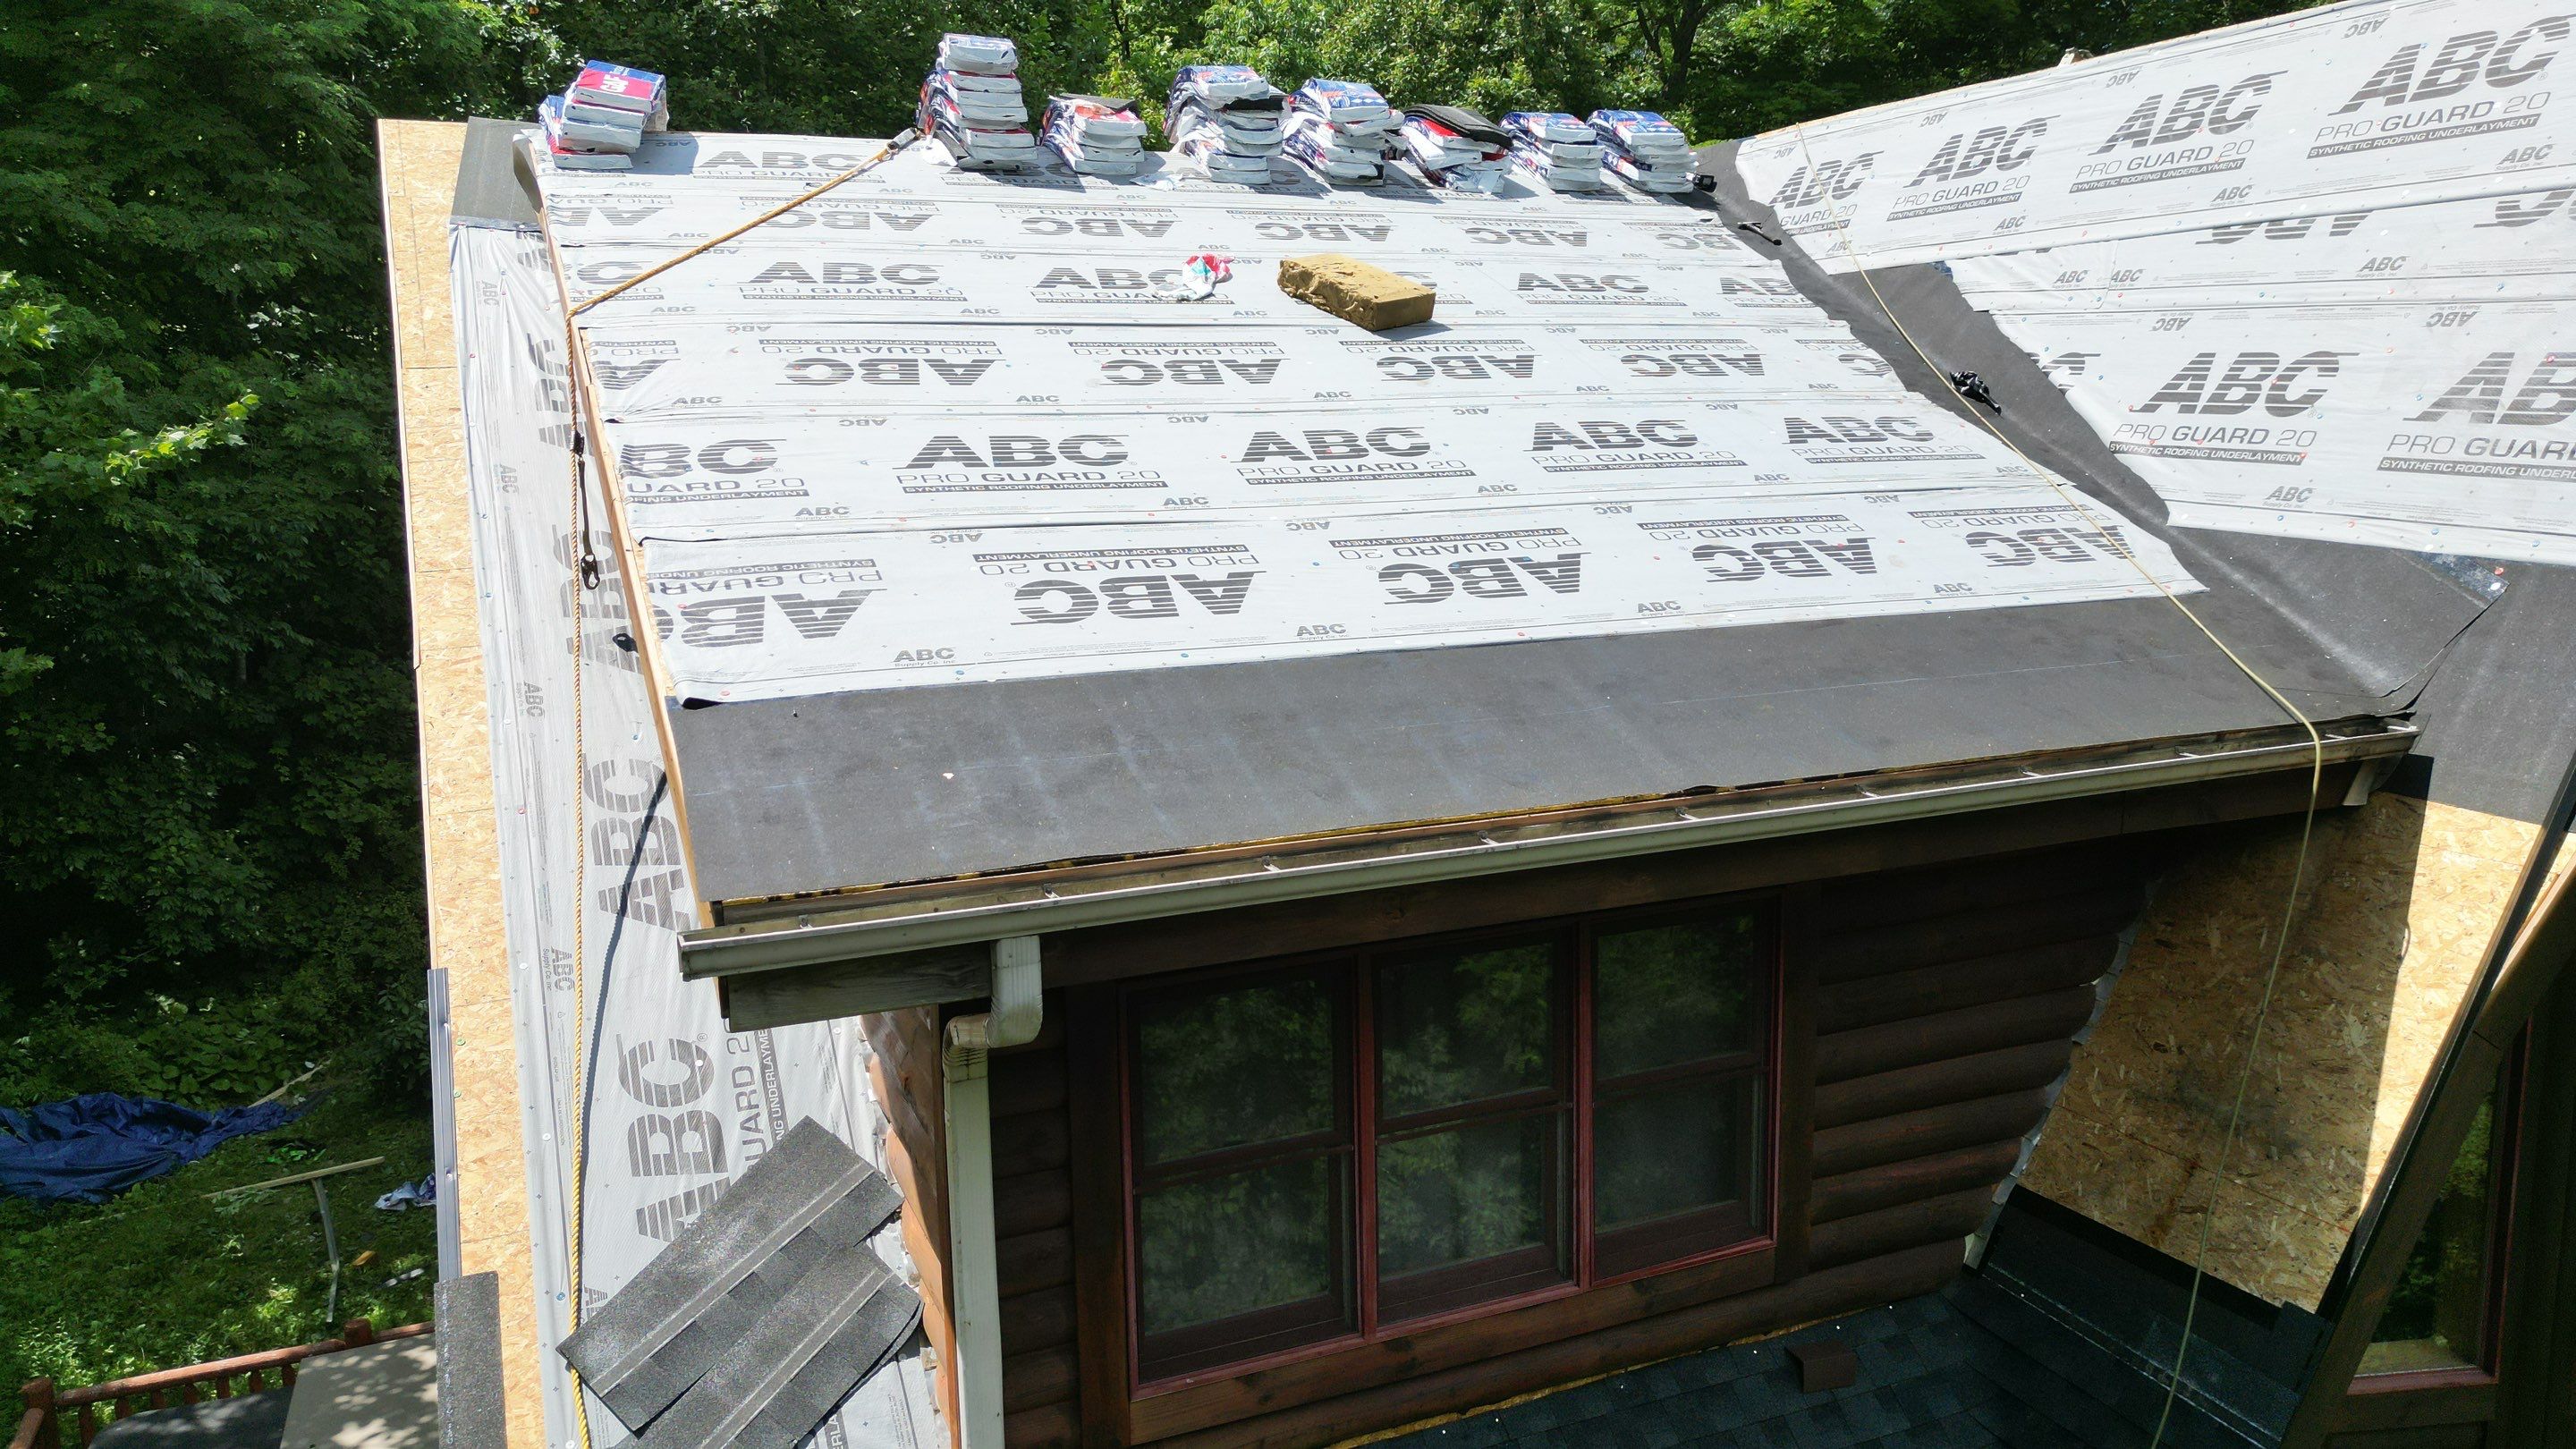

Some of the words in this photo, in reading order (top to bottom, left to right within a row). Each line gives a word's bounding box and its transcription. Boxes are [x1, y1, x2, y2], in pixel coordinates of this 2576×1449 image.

[2343, 17, 2390, 39] ABC
[2327, 13, 2576, 117] ABC
[2106, 70, 2140, 88] ABC
[1921, 111, 1948, 128] ABC
[2088, 71, 2289, 156] ABC
[2314, 120, 2374, 143] PRO
[2380, 100, 2496, 132] GUARD
[2504, 91, 2552, 114] 20
[2309, 140, 2371, 157] SYNTHETIC
[2372, 132, 2426, 148] ROOFING
[2428, 116, 2538, 139] UNDERLAYMENT
[1902, 114, 2061, 189] ABC
[2497, 144, 2555, 165] ABC
[2076, 160, 2122, 179] PRO
[2126, 146, 2215, 171] GUARD
[2218, 140, 2255, 158] 20
[2162, 161, 2242, 179] UNDERLAYMENT
[1768, 150, 1885, 209] ABC
[1893, 192, 1928, 208] PRO
[1933, 181, 1999, 203] GUARD
[2003, 174, 2031, 191] 20
[2212, 183, 2253, 202] ABC
[1018, 216, 1182, 237] ABC
[1995, 215, 2029, 231] ABC
[1254, 223, 1397, 242] ABC
[1464, 227, 1593, 247] ABC
[2357, 255, 2409, 273] ABC
[737, 261, 944, 284] ABC
[2054, 269, 2089, 284] ABC
[2111, 268, 2146, 283] ABC
[1512, 272, 1650, 293] ABC
[481, 279, 500, 308] ABC
[739, 286, 800, 294] PRO
[809, 287, 915, 295] GUARD
[1030, 291, 1091, 299] PRO
[2150, 317, 2191, 332] ABC
[2423, 310, 2480, 328] ABC
[726, 325, 772, 333] ABC
[761, 346, 804, 355] 20
[816, 346, 930, 355] GUARD
[941, 347, 1003, 356] PRO
[1072, 347, 1110, 356] 20
[1122, 347, 1223, 356] GUARD
[1231, 346, 1284, 356] PRO
[1387, 345, 1479, 353] GUARD
[775, 358, 1006, 386] ABC
[1100, 359, 1290, 386] ABC
[1377, 355, 1541, 382] ABC
[1620, 353, 1766, 377] ABC
[2130, 351, 2360, 418] ABC
[672, 395, 723, 404] ABC
[1016, 394, 1060, 403] ABC
[1314, 391, 1352, 399] ABC
[838, 418, 889, 427] ABC
[1166, 416, 1209, 424] ABC
[1523, 419, 1698, 451] ABC
[1782, 416, 1935, 445] ABC
[2113, 423, 2166, 442] PRO
[2171, 426, 2270, 445] GUARD
[2275, 429, 2318, 448] 20
[1230, 427, 1431, 463] ABC
[1792, 447, 1845, 457] PRO
[1848, 446, 1936, 455] GUARD
[2385, 434, 2457, 454] PRO
[893, 434, 1129, 470] ABC
[1531, 454, 1590, 465] PRO
[1596, 451, 1694, 462] GUARD
[1699, 450, 1737, 459] 20
[2110, 441, 2164, 455] SYNTHETIC
[2165, 447, 2208, 458] ROOFING
[2210, 450, 2303, 464] UNDERLAYMENT
[1236, 466, 1301, 477] PRO
[1309, 462, 1419, 474] GUARD
[1426, 459, 1467, 469] 20
[1375, 470, 1473, 480] UNDERLAYMENT
[2380, 459, 2453, 473] SYNTHETIC
[2454, 463, 2517, 477] ROOFING
[499, 463, 520, 494] ABC
[756, 477, 805, 488] 20
[896, 473, 970, 485] PRO
[981, 471, 1106, 482] GUARD
[1117, 470, 1161, 479] 20
[1754, 473, 1791, 481] ABC
[905, 485, 986, 493] SYNTHETIC
[987, 483, 1052, 491] ROOFING
[1054, 480, 1165, 489] UNDERLAYMENT
[1478, 484, 1518, 493] ABC
[675, 489, 805, 503] UNDERLAYMENT
[1163, 496, 1209, 506] ABC
[1864, 495, 1901, 504] ABC
[2264, 486, 2318, 503] ABC
[794, 506, 851, 517] ABC
[1593, 504, 1633, 515] ABC
[1285, 521, 1331, 531] ABC
[1807, 522, 1865, 534] PRO
[1921, 519, 1960, 529] 20
[1963, 515, 2055, 526] GUARD
[929, 532, 984, 544] ABC
[1498, 528, 1565, 537] SYNTHETIC
[1649, 530, 1691, 541] 20
[1698, 525, 1801, 538] GUARD
[1334, 535, 1435, 548] UNDERLAYMENT
[1394, 541, 1510, 556] GUARD
[1517, 537, 1582, 549] PRO
[1963, 525, 2136, 567] ABC
[976, 550, 1100, 562] UNDERLAYMENT
[1103, 547, 1167, 556] ROOFING
[1168, 545, 1246, 555] SYNTHETIC
[1339, 548, 1384, 560] 20
[781, 560, 873, 571] SYNTHETIC
[1044, 557, 1177, 572] GUARD
[1188, 555, 1260, 566] PRO
[1691, 537, 1877, 582] ABC
[703, 564, 777, 576] ROOFING
[800, 569, 883, 584] PRO
[979, 564, 1030, 575] 20
[649, 575, 784, 596] GUAR
[1377, 552, 1591, 605] ABC
[1933, 582, 1973, 594] ABC
[1010, 571, 1267, 625] ABC
[1637, 600, 1682, 613] ABC
[651, 588, 887, 648] AB
[1296, 623, 1347, 637] ABC
[894, 647, 956, 663] ABC
[523, 681, 546, 721] ABC
[581, 752, 692, 932] ABC
[542, 948, 551, 970] Supply
[551, 945, 576, 993] ABC
